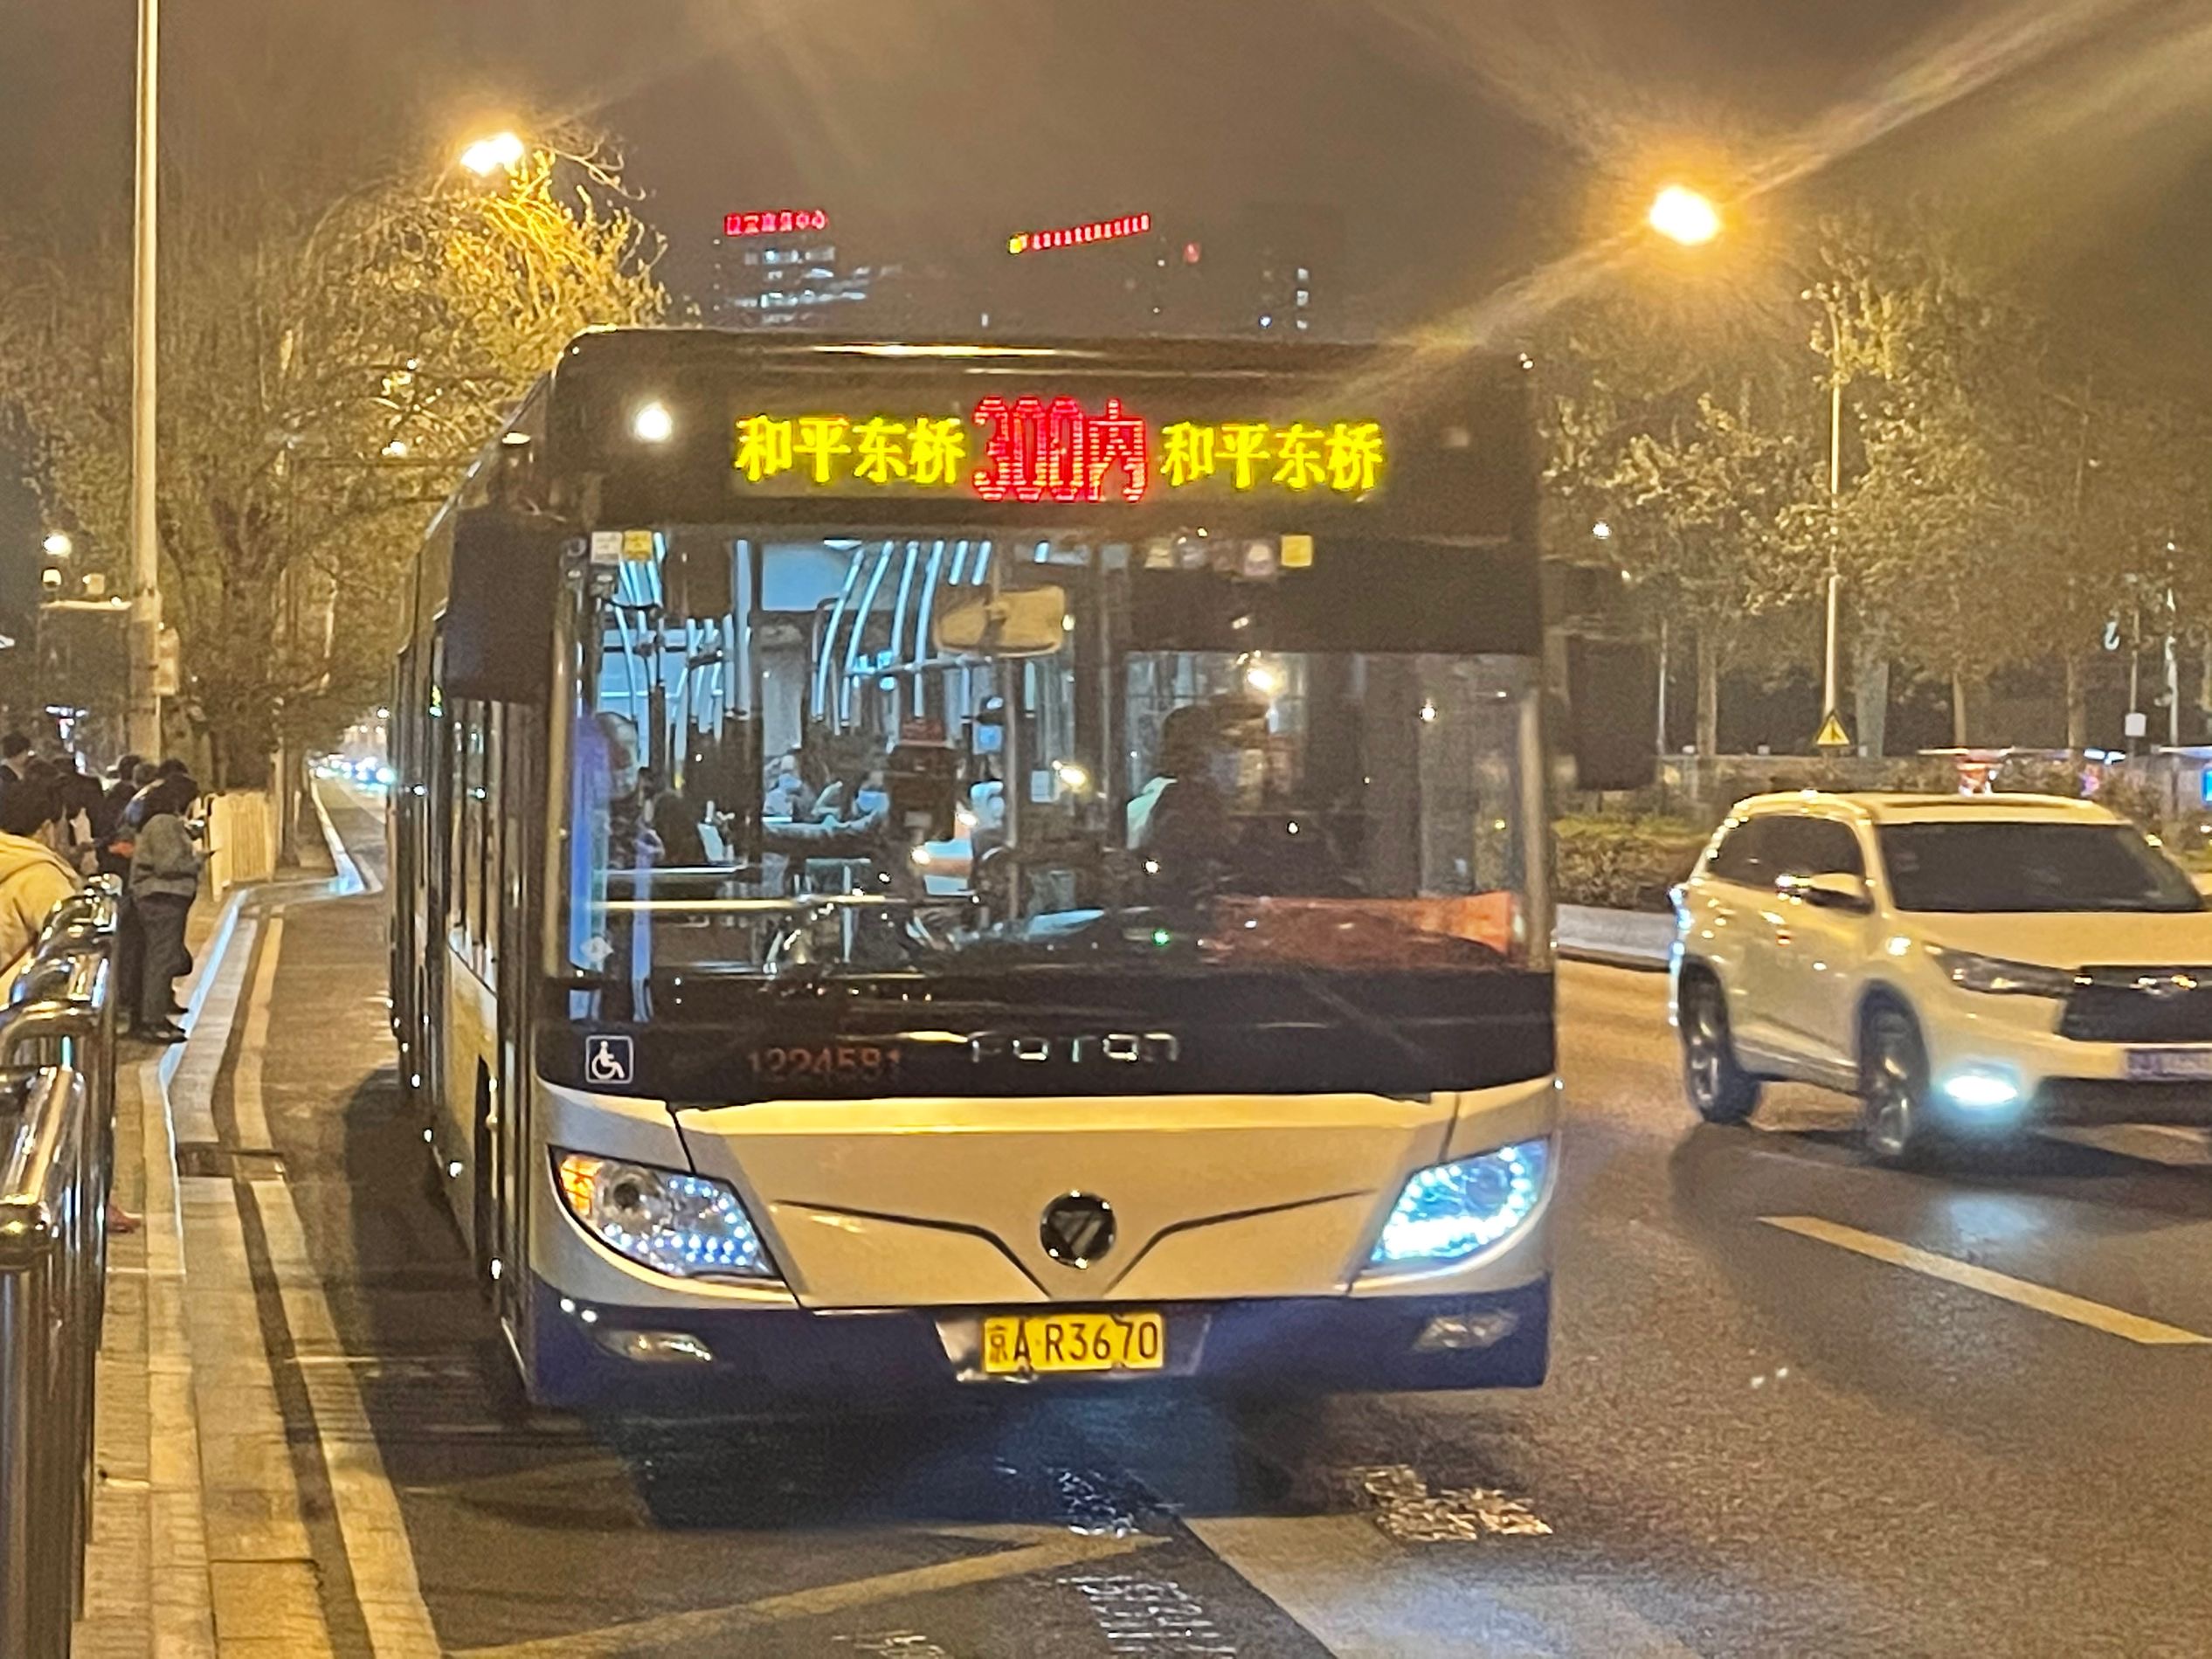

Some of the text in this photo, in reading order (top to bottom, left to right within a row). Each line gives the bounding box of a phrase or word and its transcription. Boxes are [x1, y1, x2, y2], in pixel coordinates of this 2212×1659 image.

[734, 396, 1384, 502] 和平东桥 300内 和平东桥
